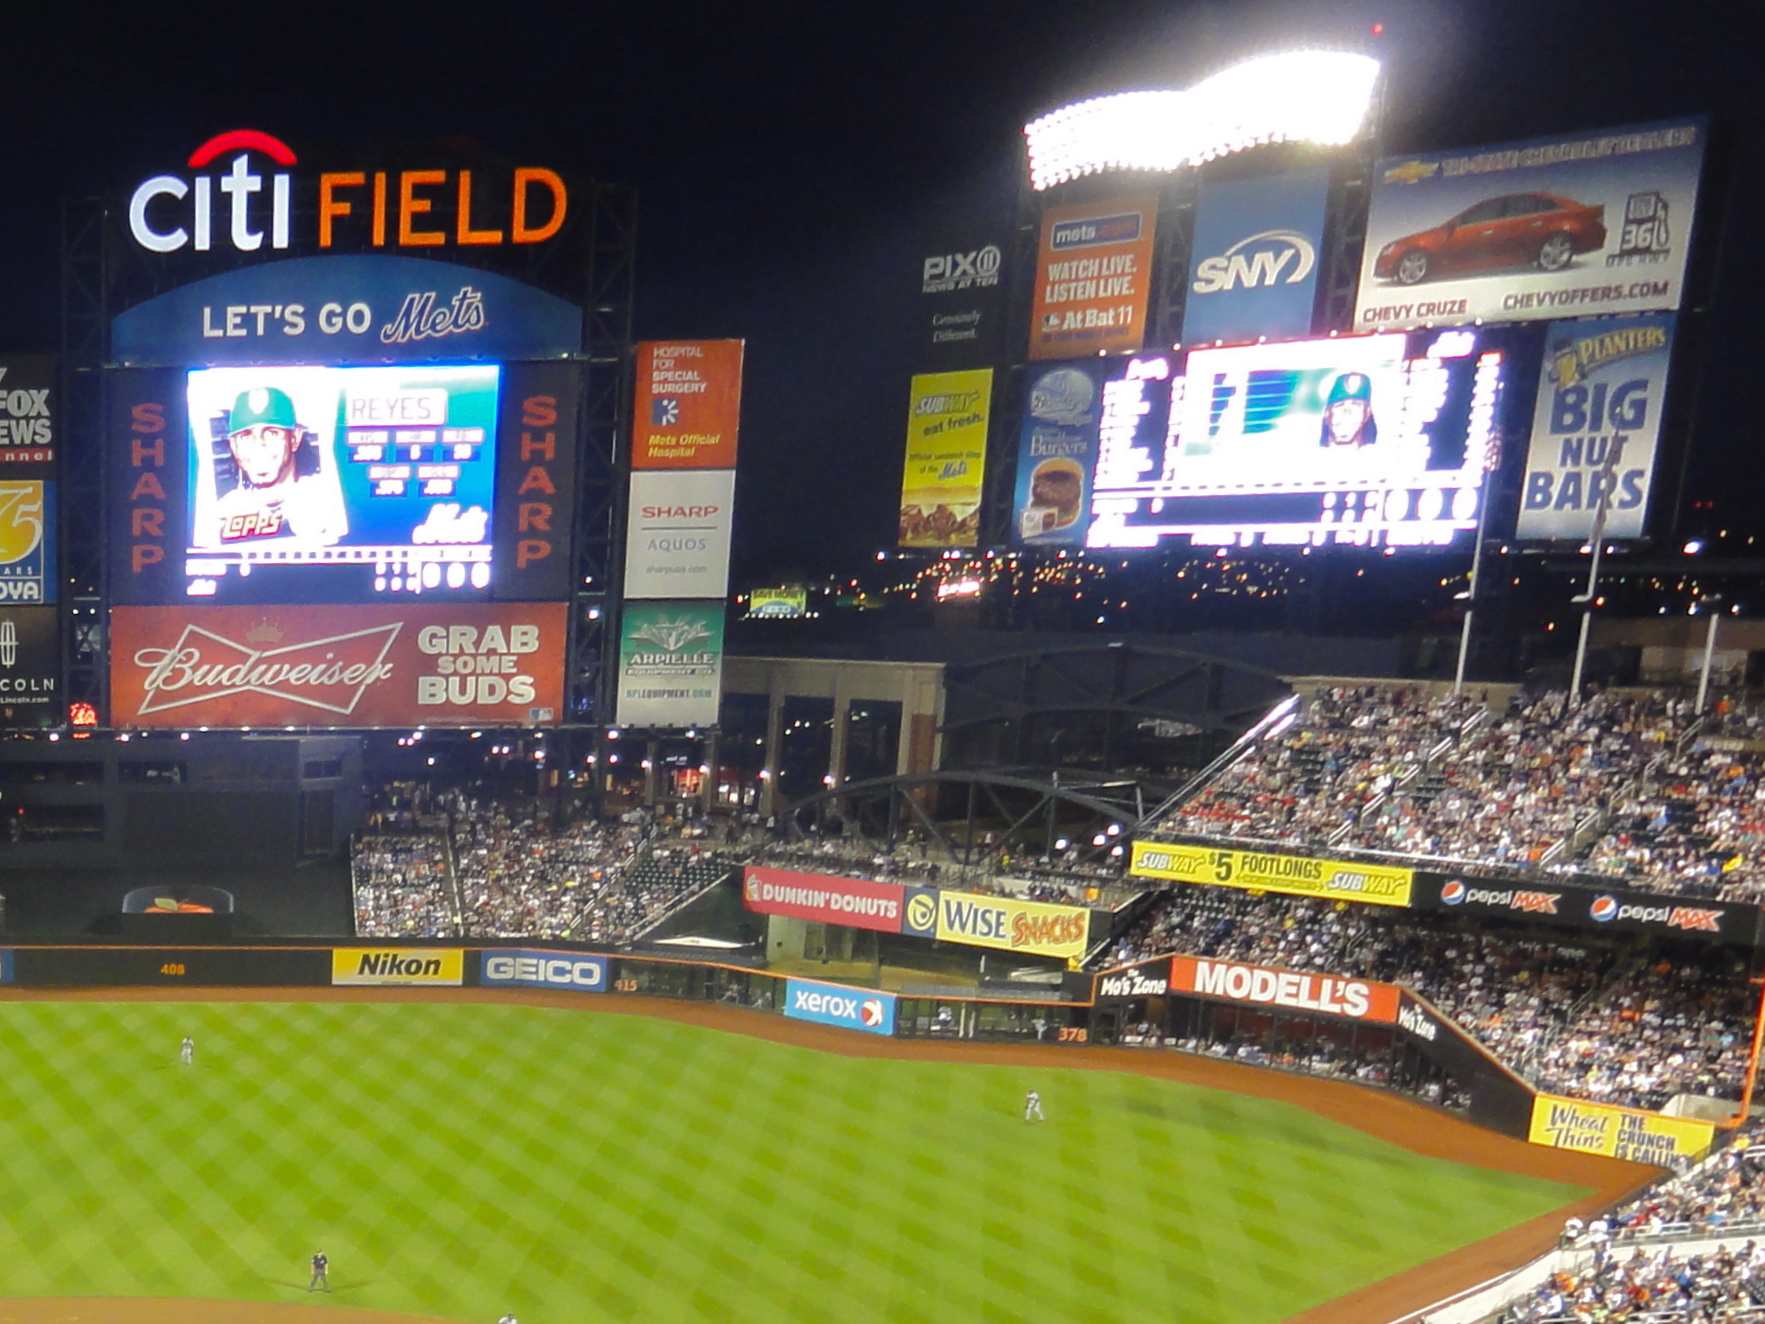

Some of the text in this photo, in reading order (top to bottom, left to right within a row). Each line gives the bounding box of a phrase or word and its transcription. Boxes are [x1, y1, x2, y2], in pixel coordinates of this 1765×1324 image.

[129, 153, 568, 252] citi FIELD
[1623, 223, 1651, 249] 36
[1048, 254, 1138, 282] WATCH LIVE.
[1193, 248, 1296, 294] SNY
[1045, 275, 1135, 304] LISTEN LIVE.
[1503, 281, 1668, 311] CHEVYOFFERS.COM
[203, 287, 486, 344] LET'S GO Mets
[1062, 305, 1133, 330] At Bat 11
[1363, 299, 1467, 323] CHEVY CRUZE
[654, 346, 703, 358] HOSPITAL
[1578, 328, 1666, 364] PLANTERS
[653, 359, 674, 369] FOR
[653, 370, 700, 381] SPECIAL
[652, 382, 707, 393] SURGERY
[350, 397, 433, 421] REYES
[915, 391, 980, 415] SUBWAY
[1549, 380, 1649, 435] BIG
[649, 434, 720, 446] Mets Official
[924, 423, 943, 435] eat
[648, 446, 695, 459] Hospital
[1559, 436, 1628, 467] NUT
[130, 402, 166, 574] SHARP
[516, 395, 558, 570] SHARP
[1525, 470, 1645, 511] BARS
[641, 506, 719, 519] SHARP
[647, 538, 707, 551] AQUOS
[418, 625, 539, 654] GRAB
[135, 648, 393, 691] Budweiser
[437, 655, 517, 674] SOME
[631, 653, 714, 665] ARPIELLE
[418, 676, 536, 705] BUDS
[1138, 852, 1206, 874] SUBWAY
[1208, 852, 1232, 881] $5
[1240, 855, 1322, 880] FOOTLONGS
[1328, 872, 1407, 896] SUBWAY
[762, 883, 897, 919] DUNKIN' DONUTS
[1465, 889, 1561, 914] pepsi MAX
[945, 900, 1085, 947] WISE SNACKS
[1618, 905, 1725, 932] pepsi MAX
[160, 963, 185, 976] 408
[357, 953, 441, 976] Nikon
[486, 956, 601, 986] GEICO
[615, 979, 638, 992] 415
[1101, 975, 1167, 997] Mo's Zone
[1194, 962, 1369, 1017] MODELL'S
[795, 990, 857, 1020] xerox
[1058, 1027, 1087, 1043] 378
[1550, 1104, 1609, 1133] Wheat
[1621, 1114, 1646, 1130] THE
[1545, 1128, 1605, 1149] Thins
[1617, 1130, 1677, 1151] CRUNCH
